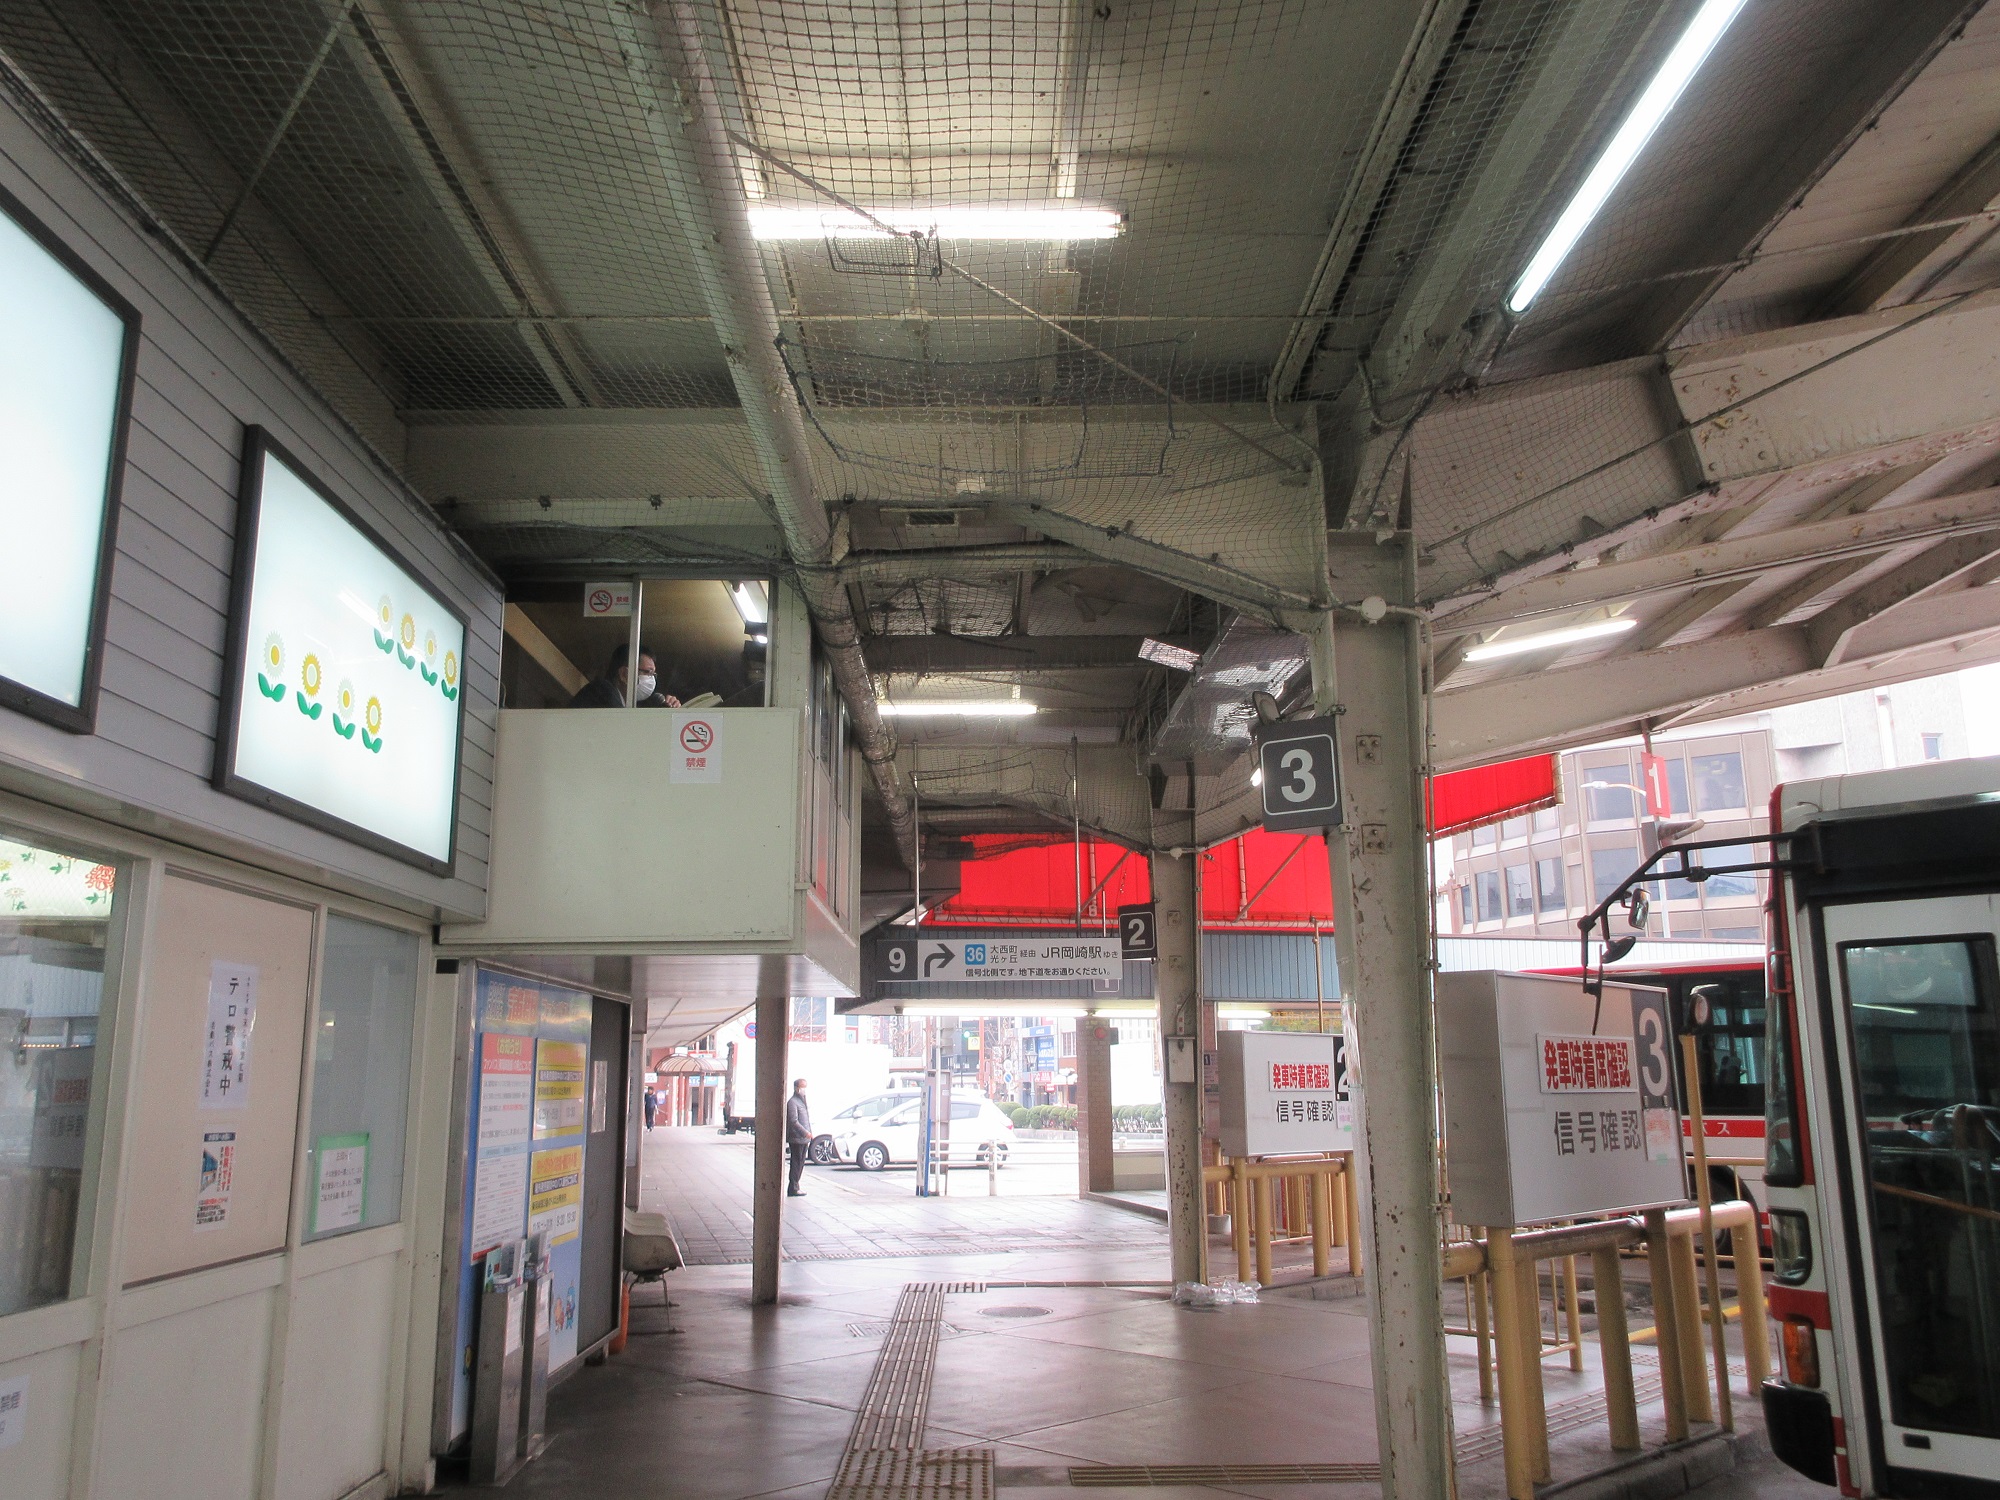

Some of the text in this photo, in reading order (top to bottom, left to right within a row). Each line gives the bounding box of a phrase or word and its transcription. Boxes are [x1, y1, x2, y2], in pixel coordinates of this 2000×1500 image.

[686, 757, 707, 768] 禁煙
[1280, 748, 1317, 803] 3
[1648, 762, 1662, 809] 1
[1127, 918, 1148, 946] 2
[887, 947, 907, 973] 9
[966, 946, 984, 962] 36
[990, 945, 1018, 954] 大西町
[1019, 949, 1036, 958] 経由
[218, 976, 240, 1096] テロ警戒中
[1543, 1039, 1632, 1090] 発車時着席確認
[1638, 1007, 1669, 1097] 3
[1272, 1063, 1330, 1090] 発車時着席確認
[1276, 1100, 1335, 1123] 信号確認
[1553, 1109, 1642, 1156] 信号確認
